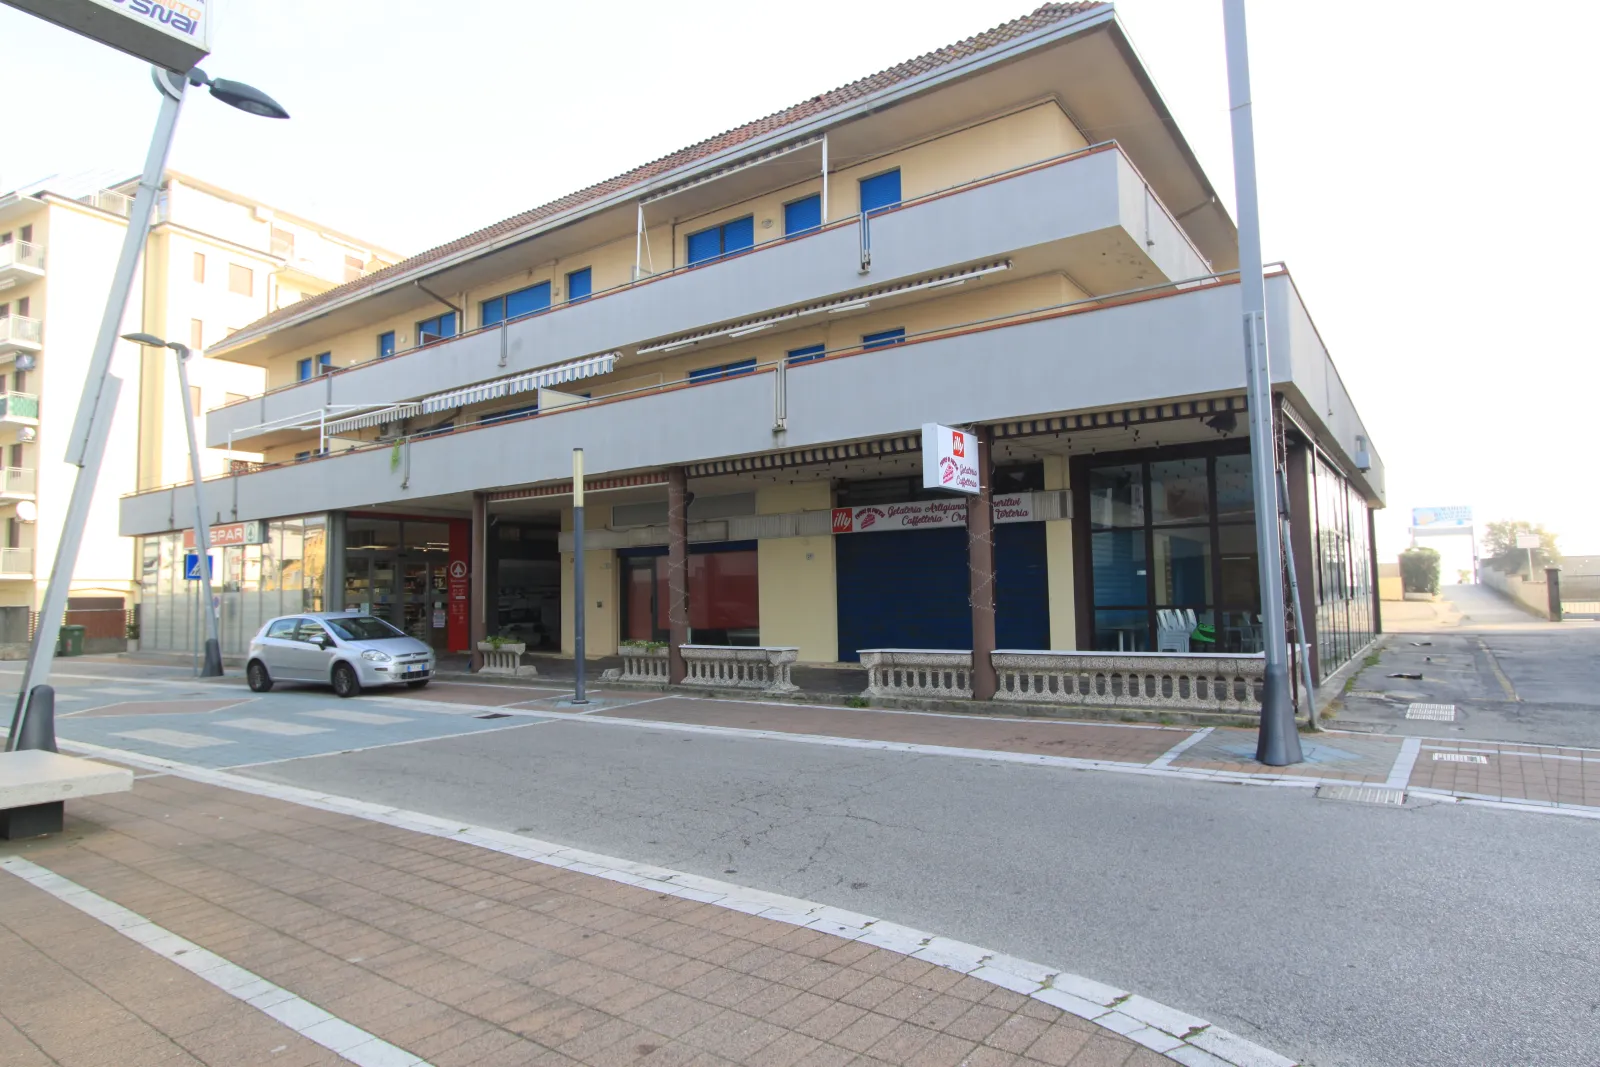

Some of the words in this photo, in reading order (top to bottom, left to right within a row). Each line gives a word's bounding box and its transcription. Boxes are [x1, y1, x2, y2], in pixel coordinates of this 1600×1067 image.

[953, 436, 964, 455] illy
[887, 506, 922, 518] Gelateria
[924, 502, 967, 514] Artigiana
[833, 511, 851, 530] illy
[901, 514, 944, 526] Caffetteria
